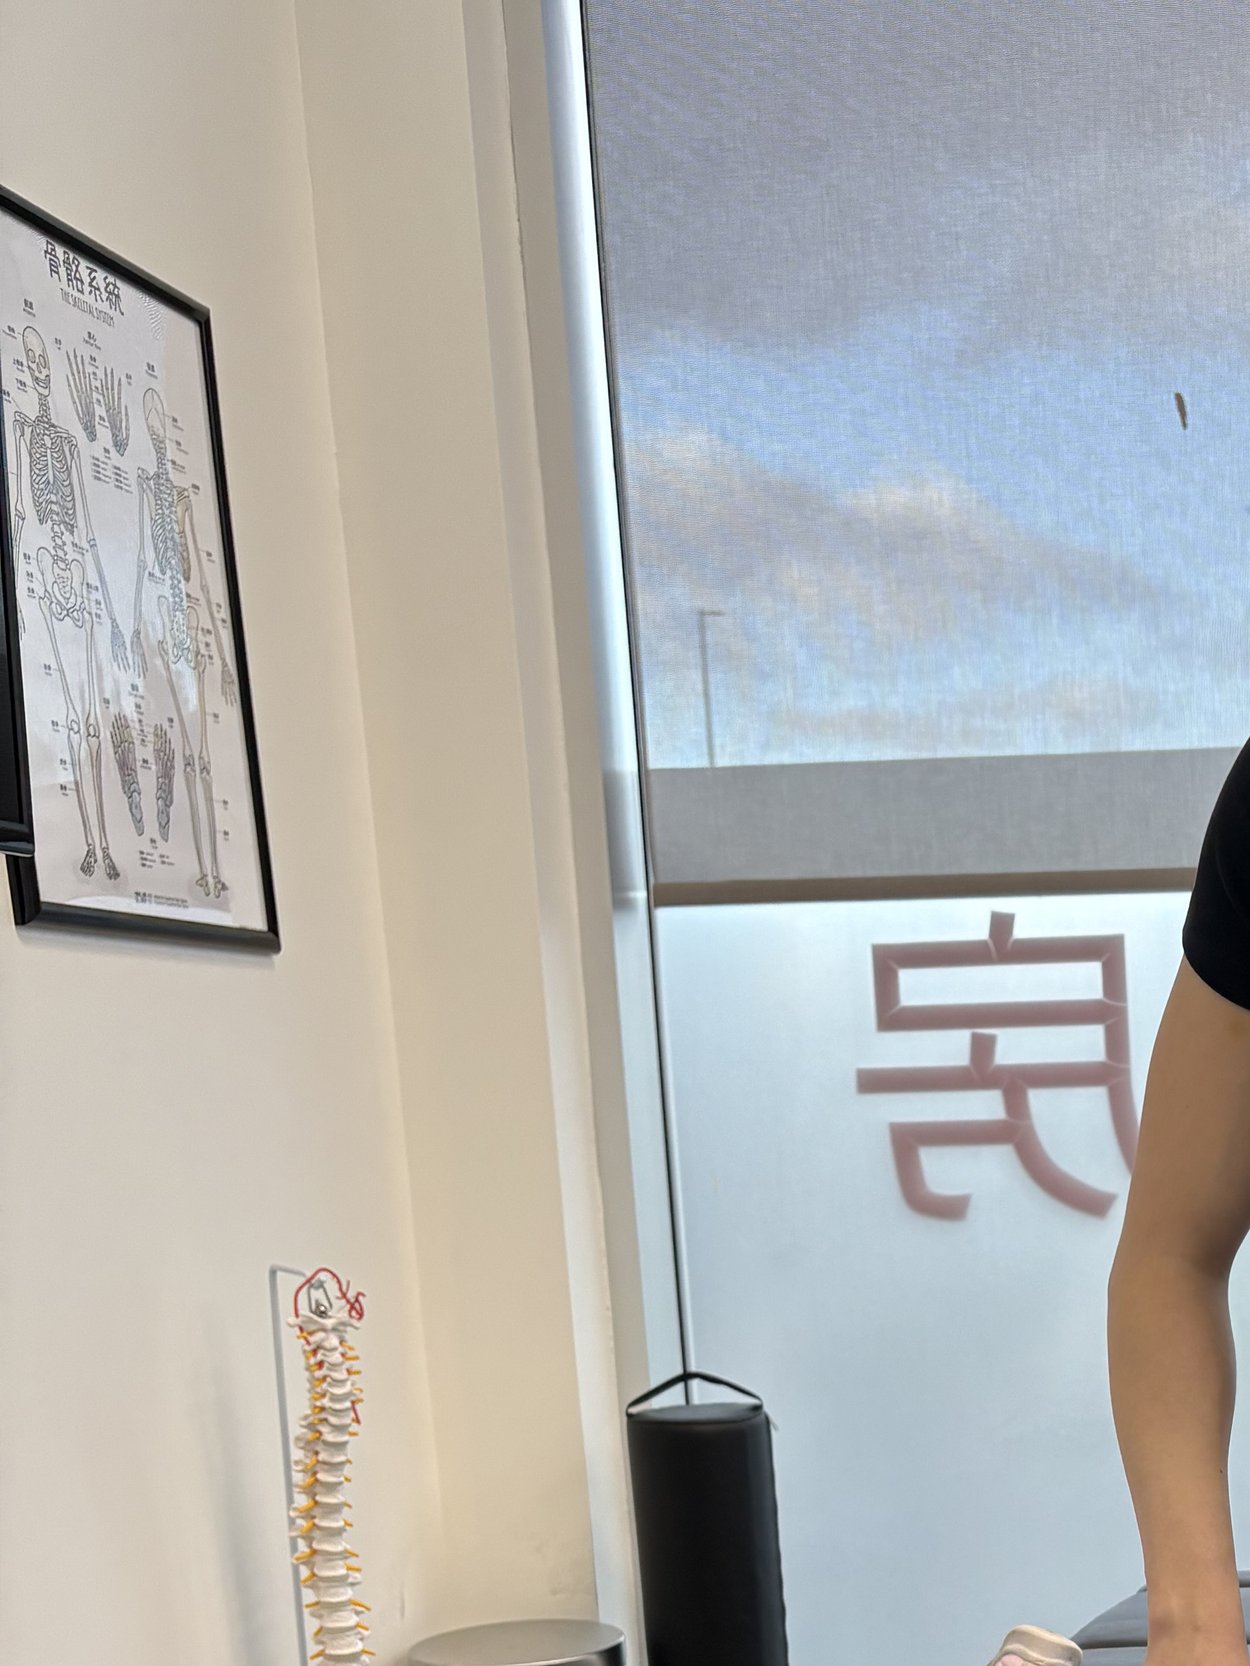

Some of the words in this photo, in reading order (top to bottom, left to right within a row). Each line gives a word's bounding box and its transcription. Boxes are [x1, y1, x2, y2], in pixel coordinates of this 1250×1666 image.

[44, 239, 125, 316] 骨骼系統
[60, 287, 71, 305] THE
[71, 293, 96, 319] SKELETAL
[95, 306, 115, 328] SYSTEM
